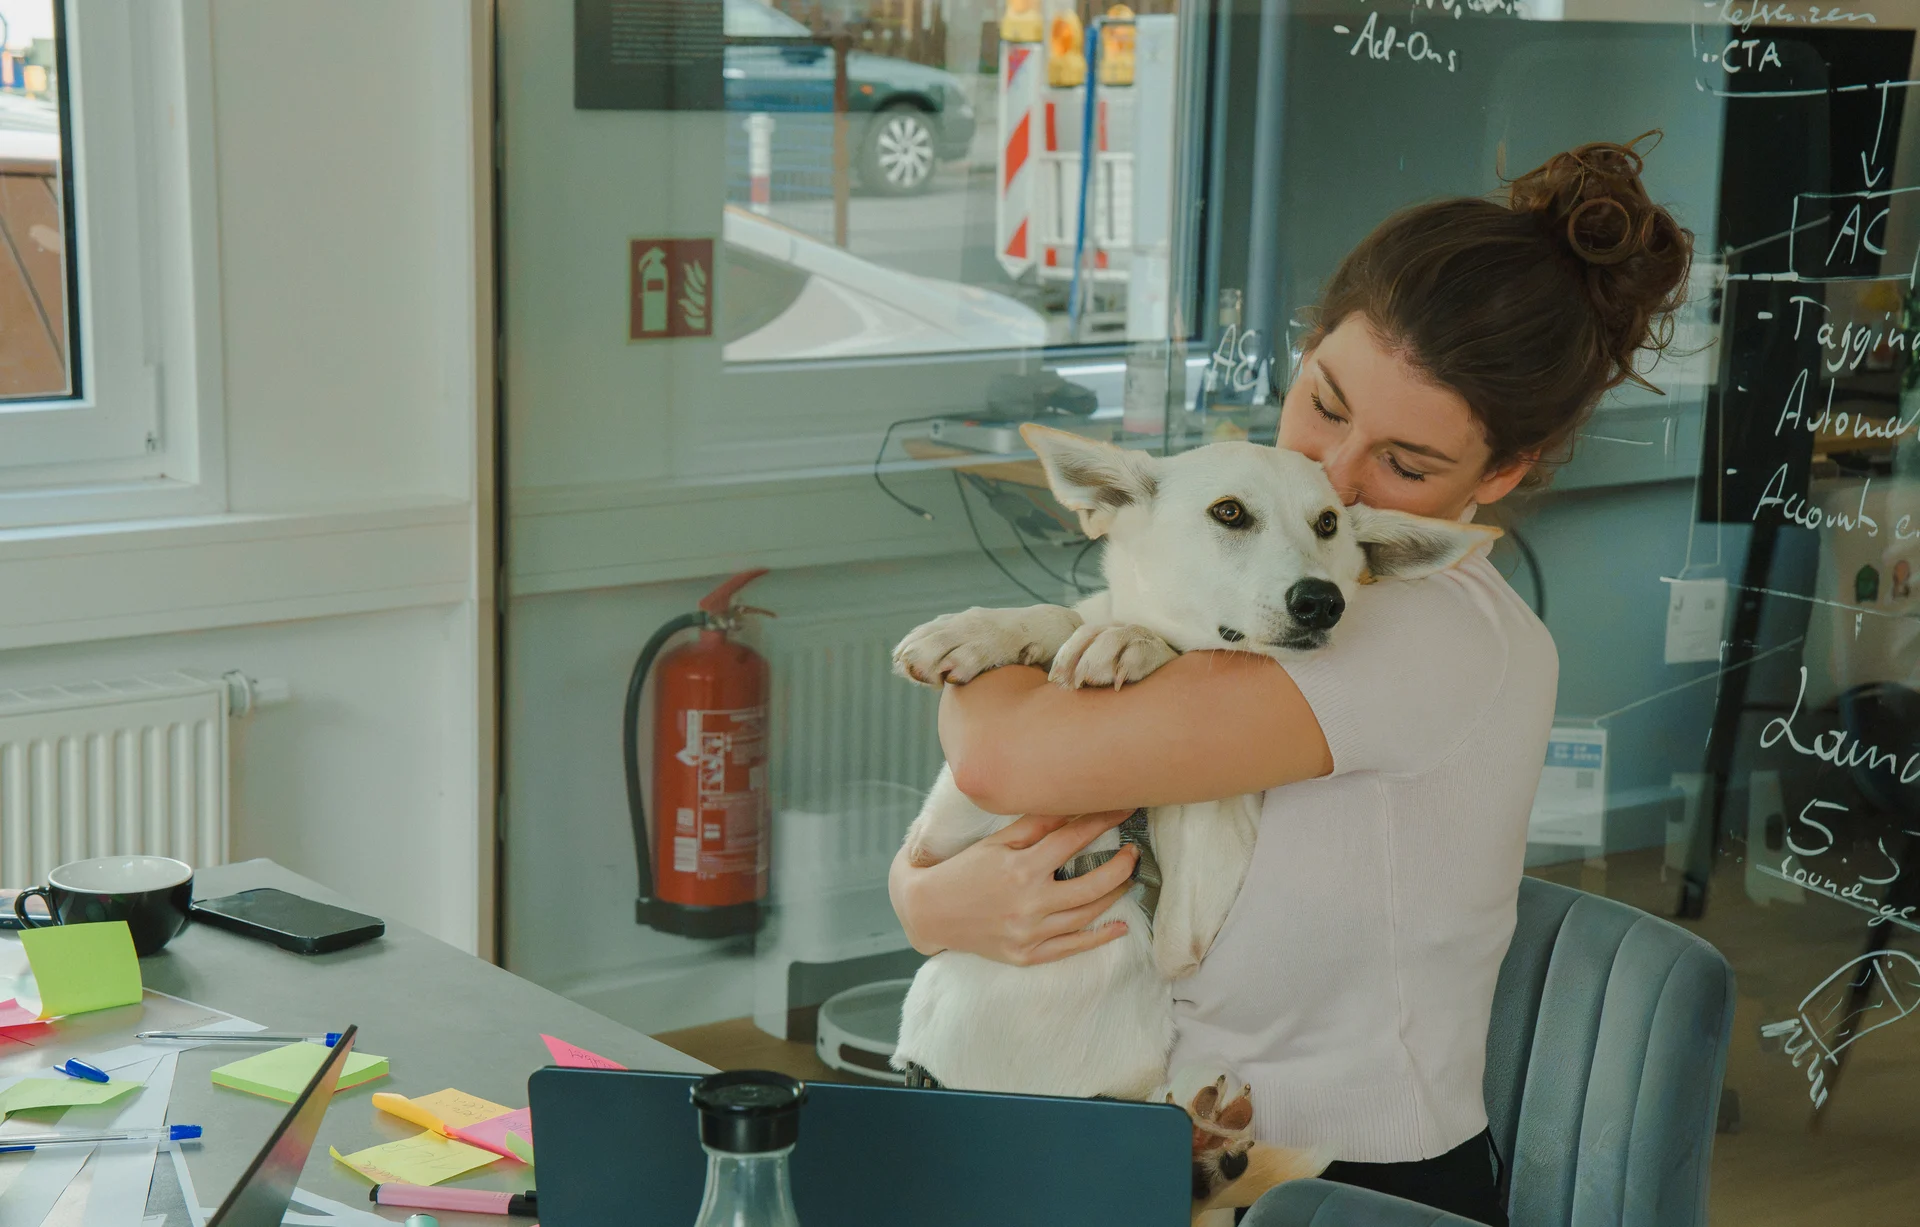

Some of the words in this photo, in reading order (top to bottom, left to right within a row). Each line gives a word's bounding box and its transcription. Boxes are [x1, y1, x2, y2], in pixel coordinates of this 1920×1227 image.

[1722, 39, 1782, 73] CTA
[1825, 203, 1891, 266] AC
[1774, 368, 1920, 438] Automa
